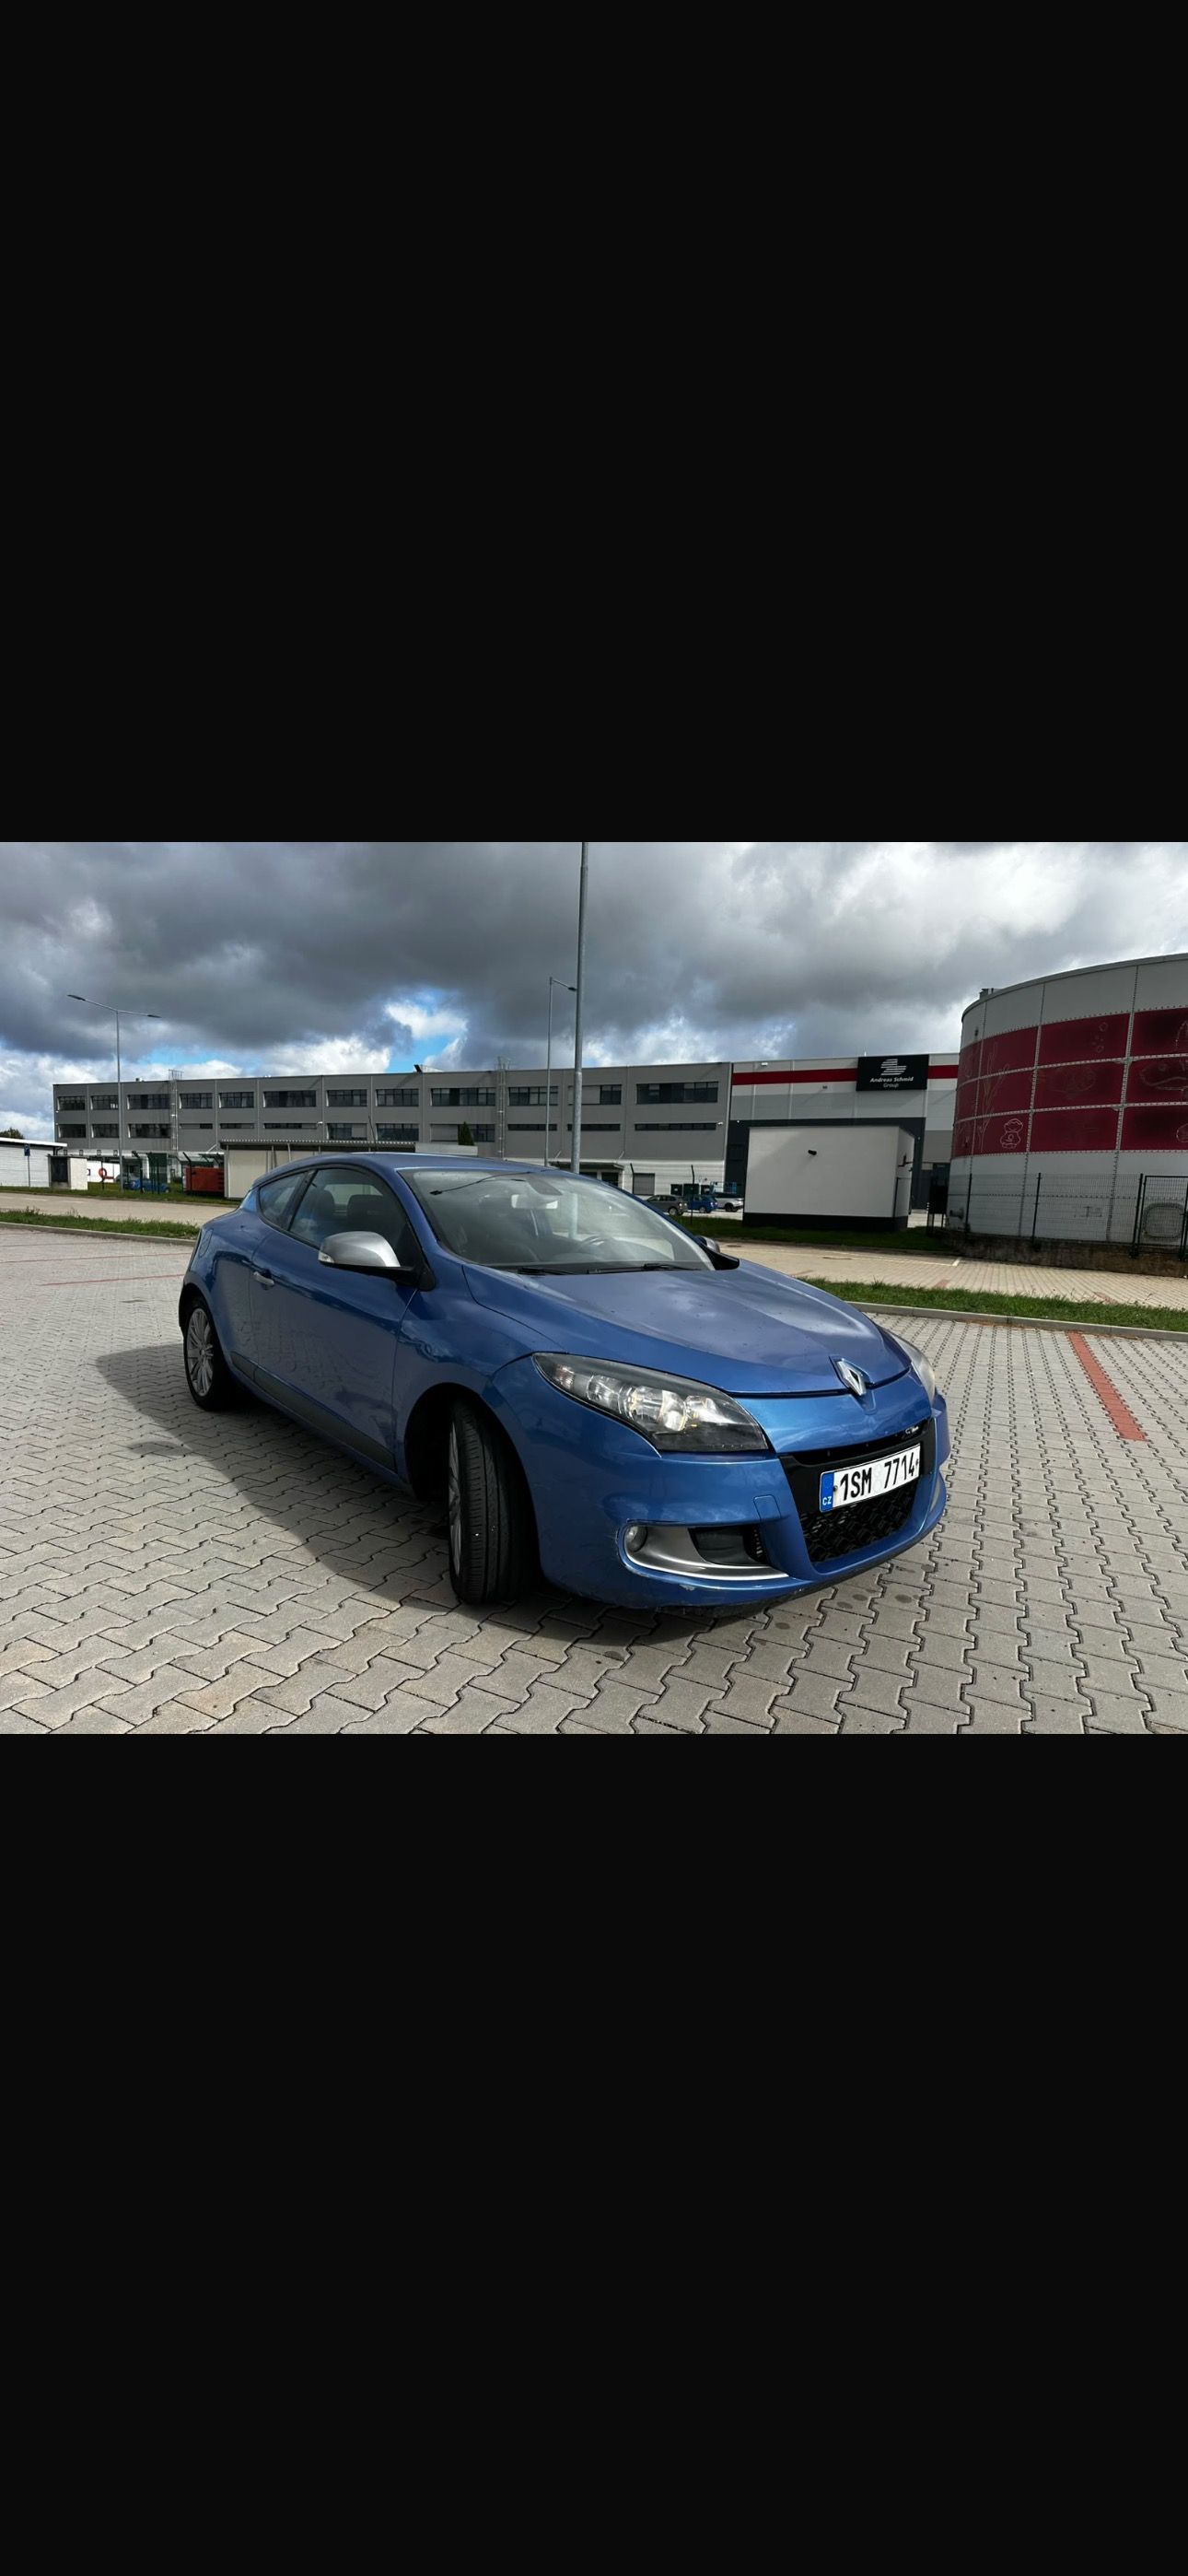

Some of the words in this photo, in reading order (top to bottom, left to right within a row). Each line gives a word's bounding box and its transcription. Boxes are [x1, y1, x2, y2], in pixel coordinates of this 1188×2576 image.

[839, 1468, 872, 1501] 1SM
[884, 1452, 914, 1489] 7714
[822, 1497, 832, 1506] CZ
